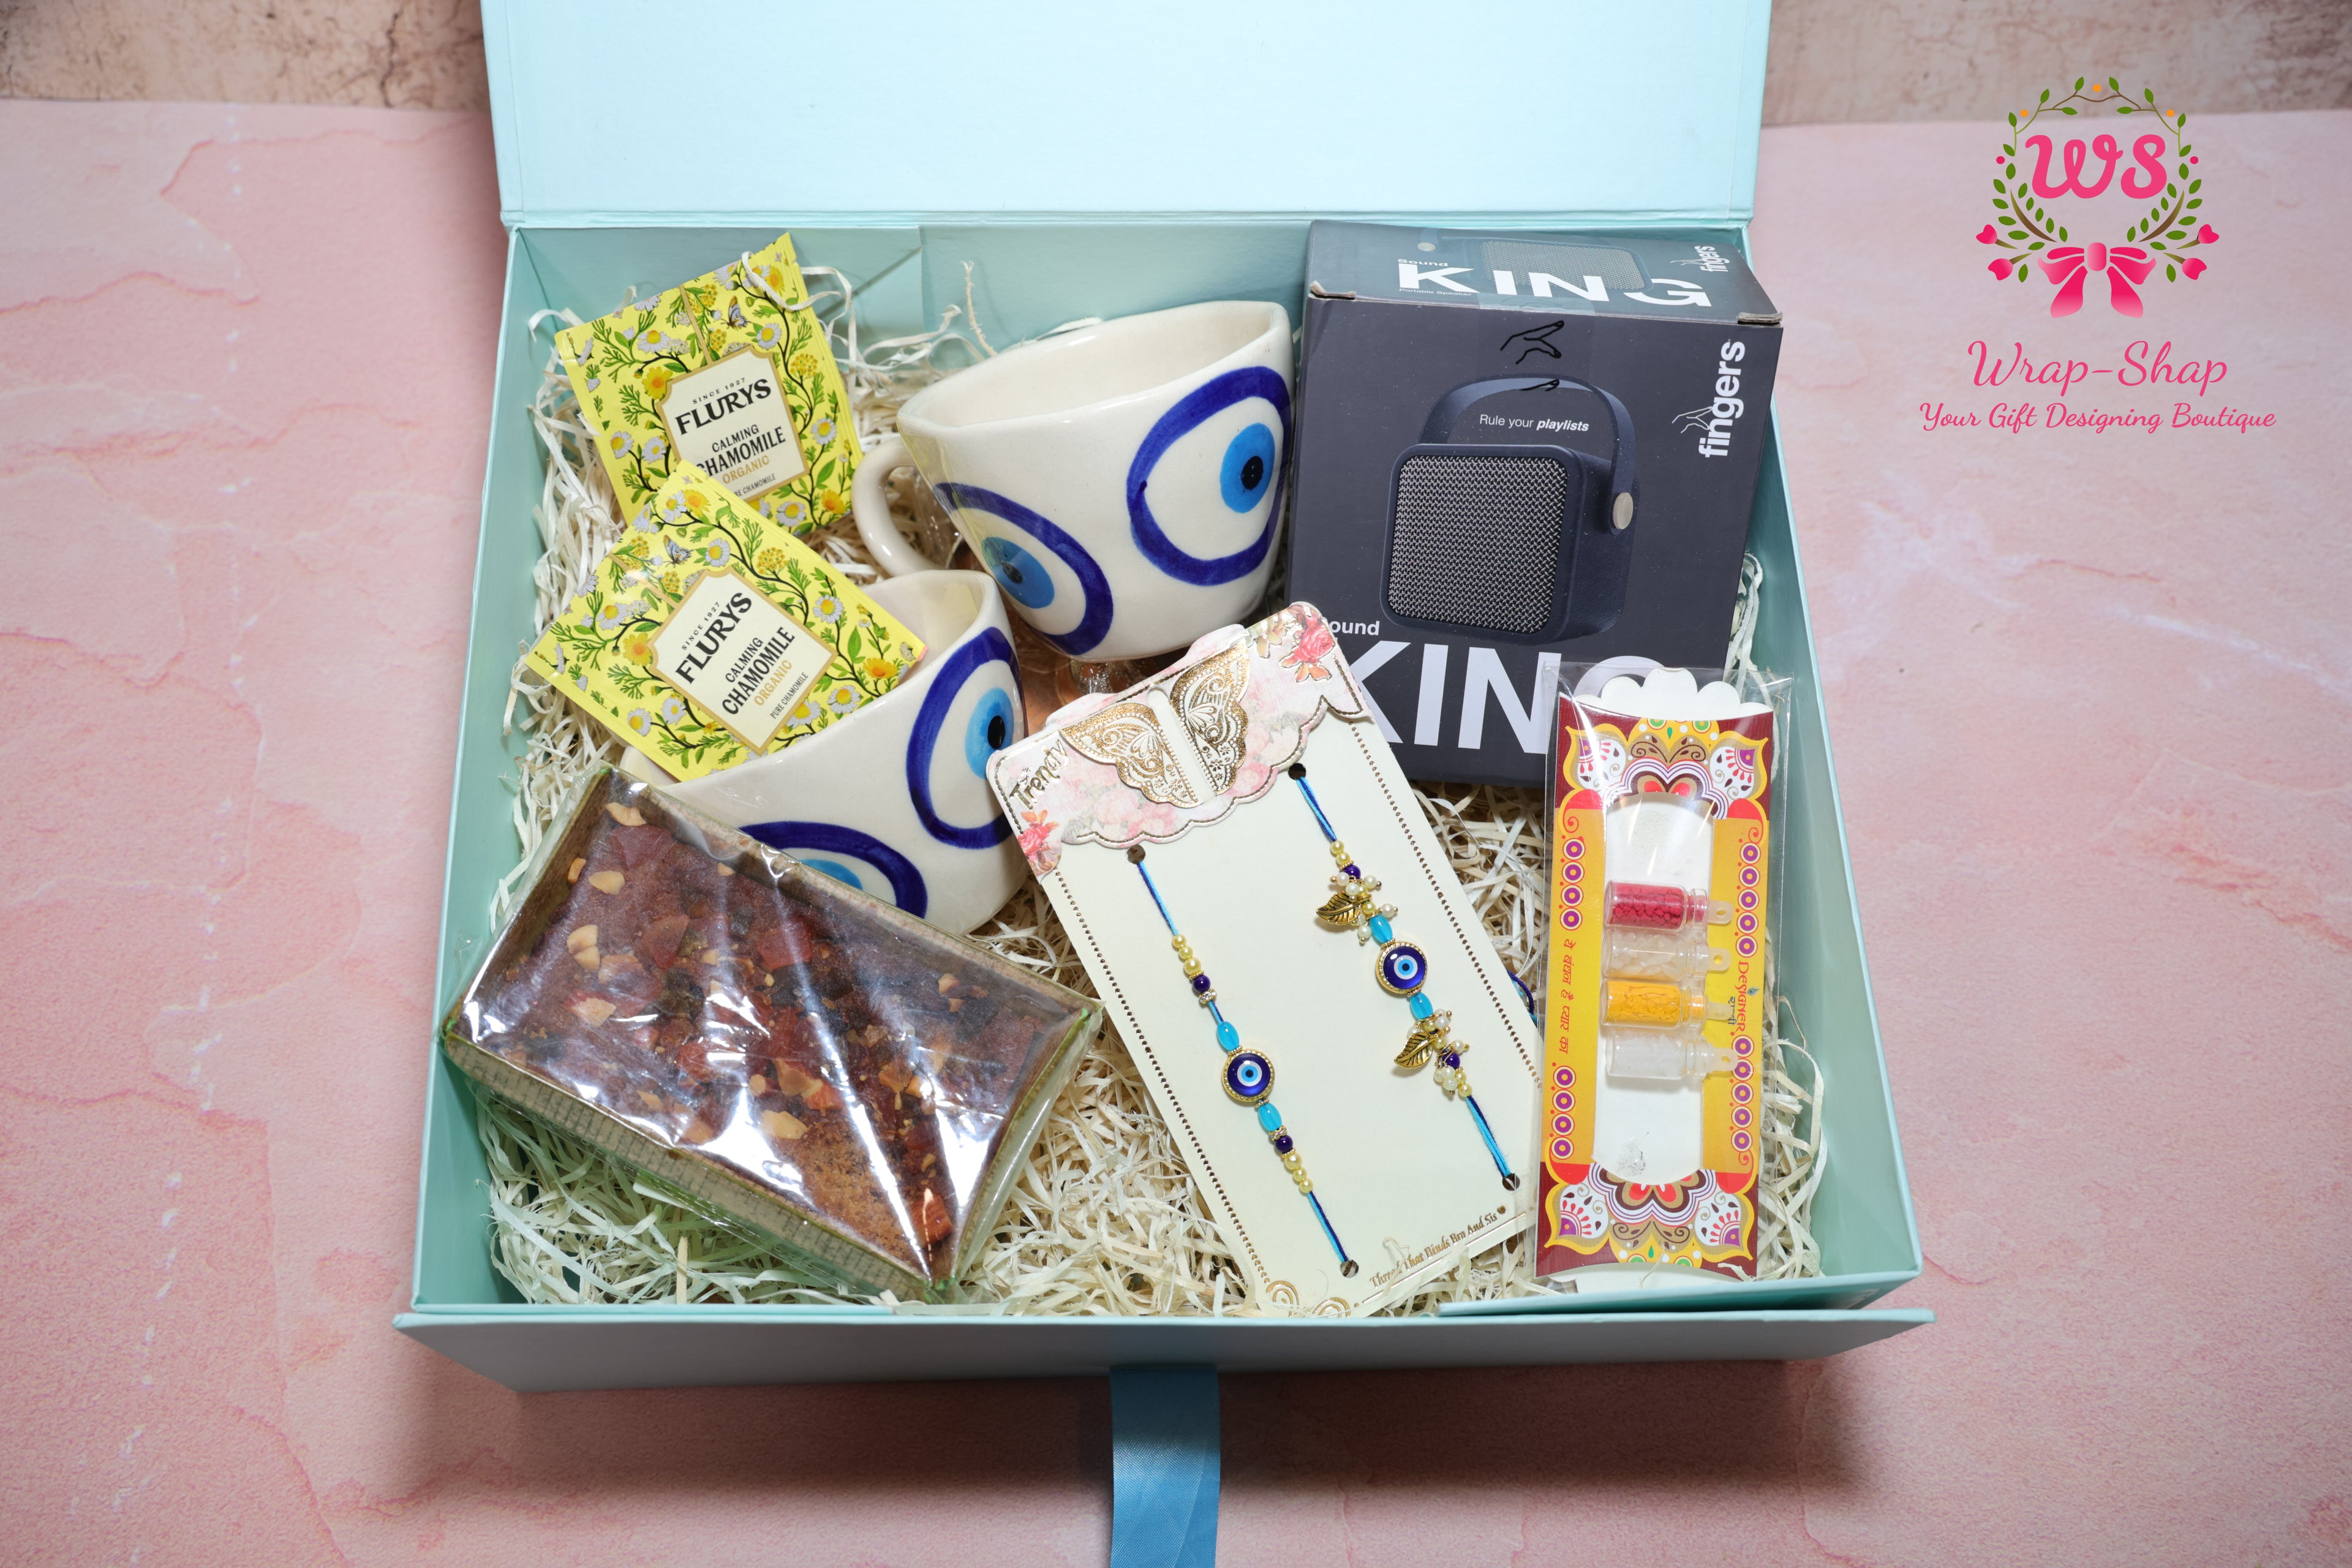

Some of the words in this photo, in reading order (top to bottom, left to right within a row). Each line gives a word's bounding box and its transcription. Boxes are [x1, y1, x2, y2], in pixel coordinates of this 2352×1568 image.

[1397, 258, 1449, 267] Sound
[1694, 246, 1730, 272] fingers
[1398, 263, 1712, 307] KING
[692, 388, 721, 404] SINCE
[725, 377, 745, 390] 1927
[1698, 341, 1746, 458] fingers
[674, 379, 771, 435] FLURYS
[1479, 413, 1505, 426] Rule
[1509, 418, 1534, 429] your
[1536, 418, 1589, 432] playlists
[712, 424, 760, 453] CALMING
[722, 455, 770, 484] ORGANIC
[743, 473, 776, 494] CHAMOMILE
[675, 592, 752, 684] FLURYS
[681, 624, 703, 650] SINCE
[704, 601, 720, 621] 1927
[1322, 616, 1380, 636] ound
[722, 627, 795, 714] CHAMOMILE
[725, 637, 764, 683] CALMING
[754, 660, 793, 706] ORGANIC
[769, 701, 785, 719] PURE
[782, 672, 809, 704] CHAMOMILE
[1009, 739, 1069, 810] Trendy
[1564, 938, 1576, 949] ये
[1561, 989, 1574, 1001] है
[1559, 1036, 1568, 1054] का
[1467, 1216, 1485, 1237] And
[1485, 1212, 1498, 1226] Sis
